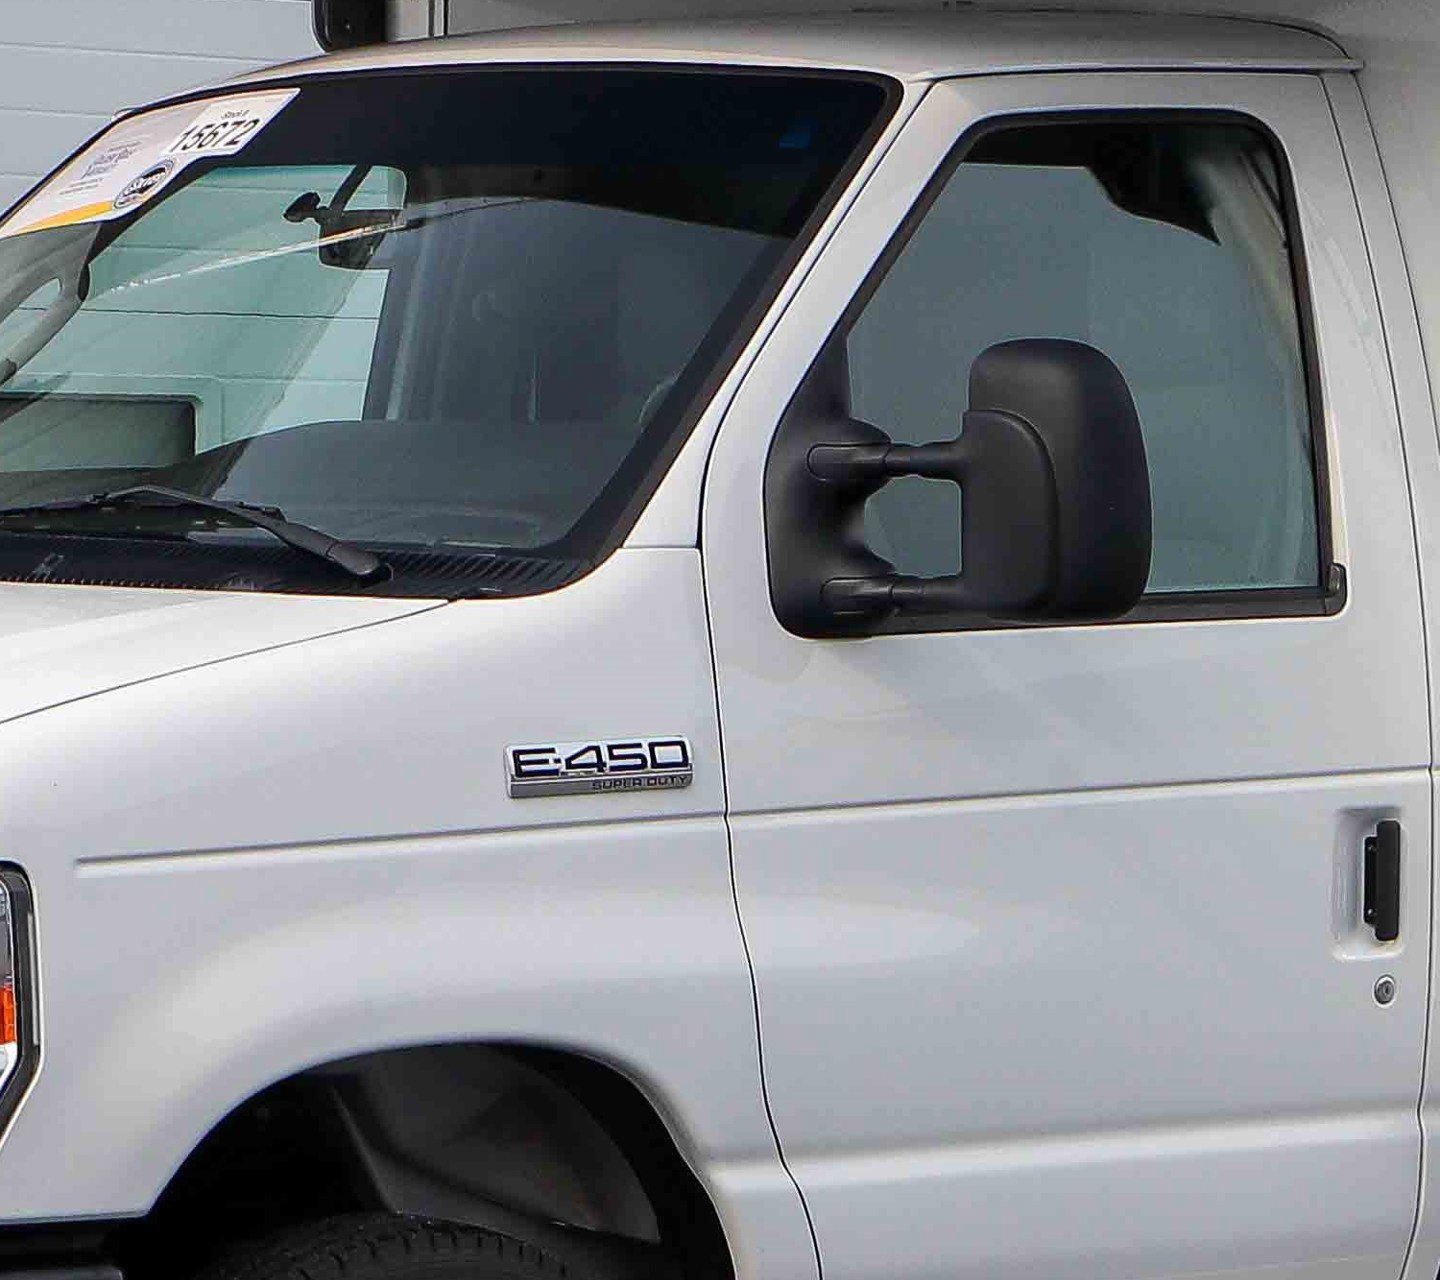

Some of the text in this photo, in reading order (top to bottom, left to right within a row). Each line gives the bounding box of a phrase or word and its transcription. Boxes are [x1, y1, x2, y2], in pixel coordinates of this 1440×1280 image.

[169, 118, 261, 152] 15672
[512, 740, 690, 777] E-450
[592, 775, 687, 791] SUPER DUTY
